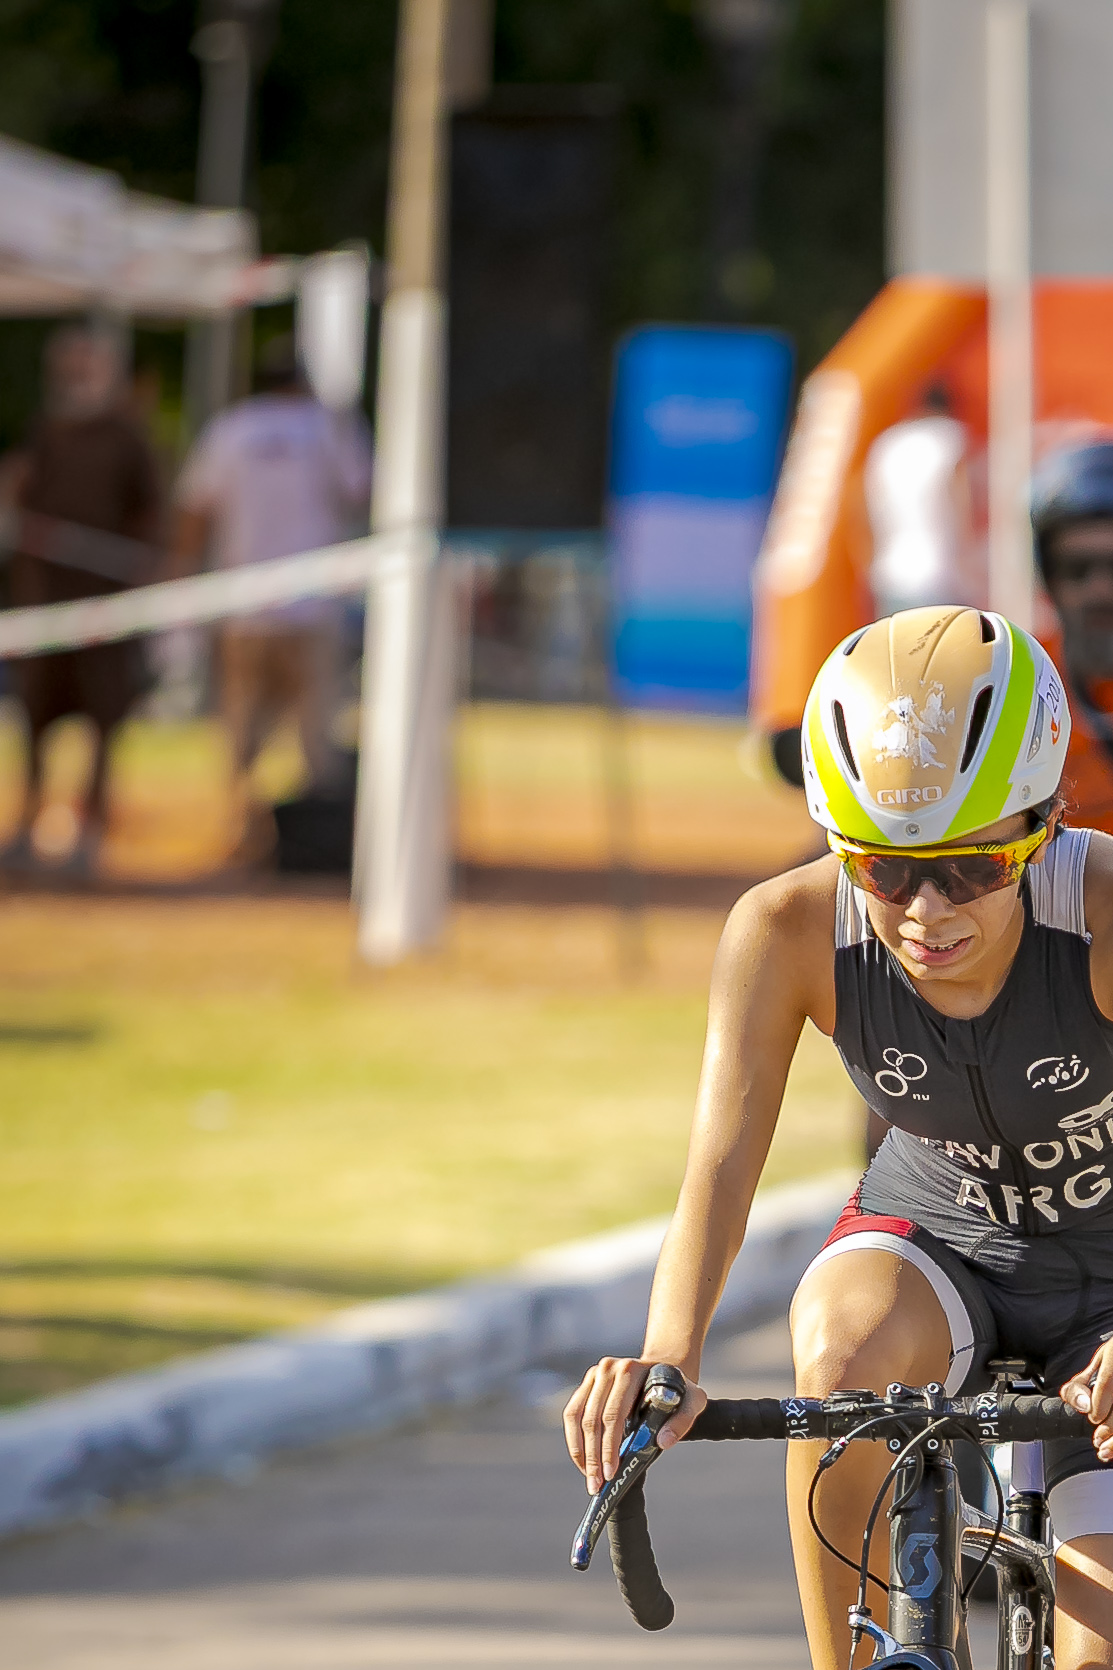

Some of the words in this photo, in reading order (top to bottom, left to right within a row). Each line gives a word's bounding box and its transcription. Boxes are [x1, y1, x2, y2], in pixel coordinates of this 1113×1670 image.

[876, 785, 943, 805] GIRO
[955, 1164, 1112, 1225] ARG
[590, 1456, 640, 1533] DURA-ACE
